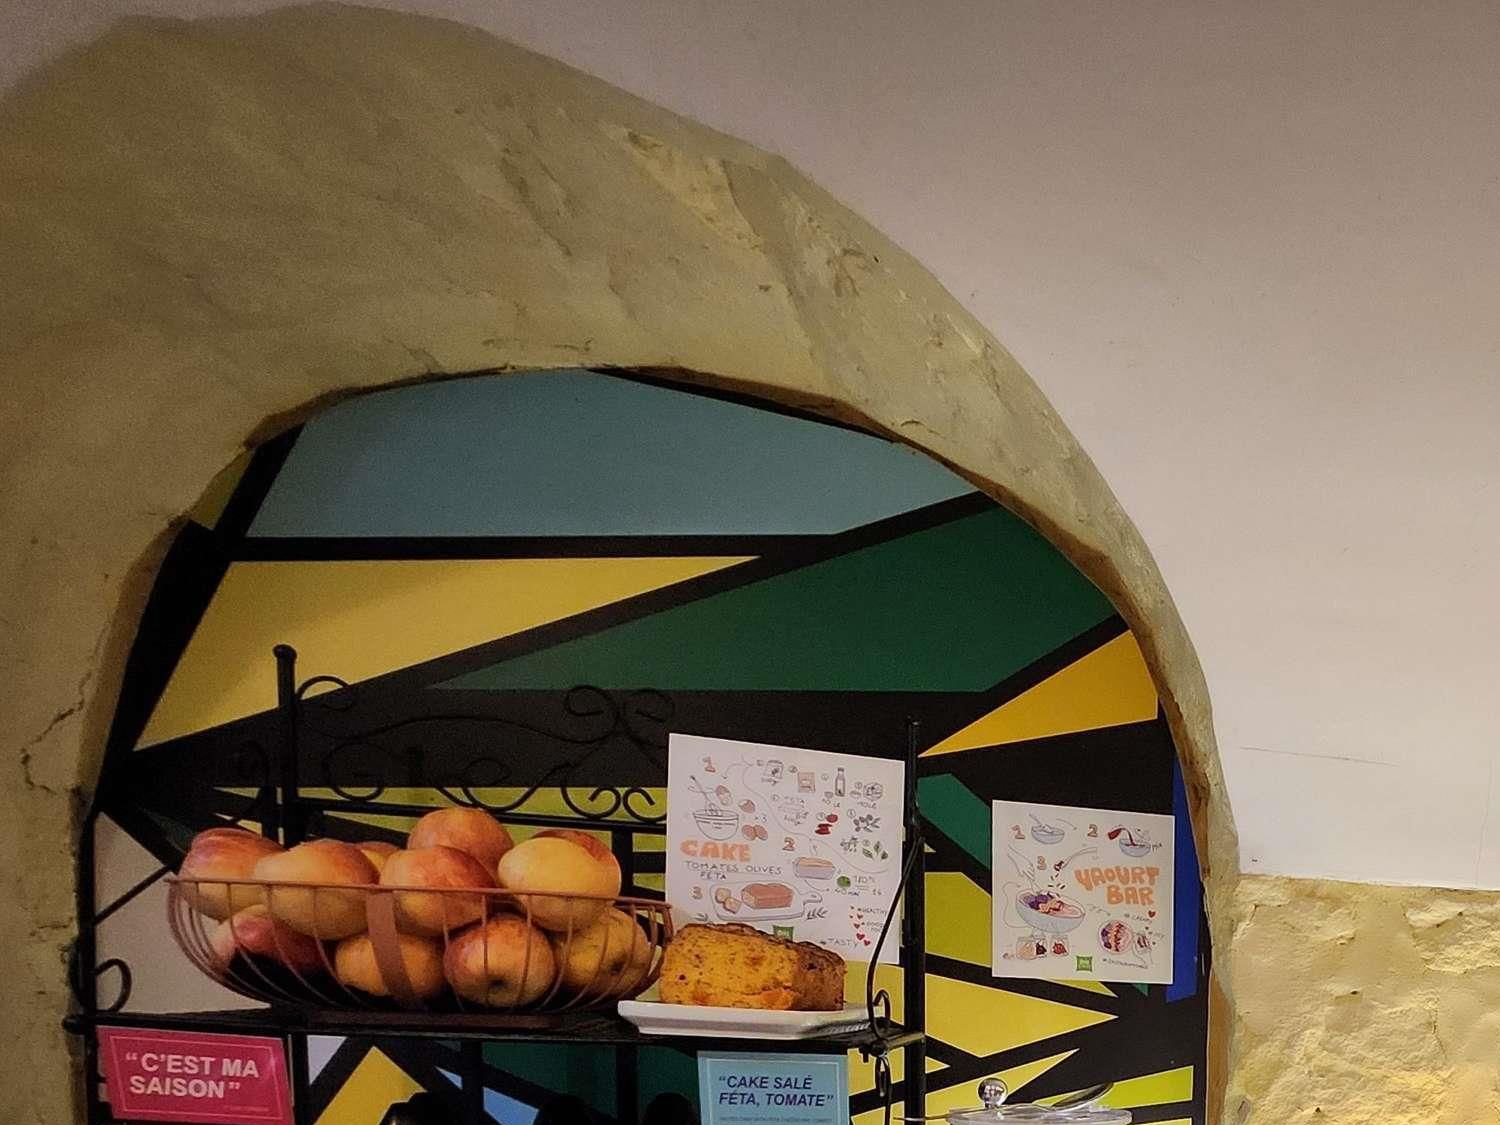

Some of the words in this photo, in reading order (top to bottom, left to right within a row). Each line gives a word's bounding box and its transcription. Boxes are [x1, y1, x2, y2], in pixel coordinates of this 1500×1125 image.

[1087, 824, 1098, 838] 2
[680, 839, 751, 862] CAKE
[782, 837, 795, 851] 2
[685, 860, 740, 873] TOMATES
[745, 865, 782, 875] OLIVES
[1074, 866, 1160, 891] YAOURT
[1106, 885, 1155, 906] BAR
[221, 1058, 260, 1078] MA
[773, 1074, 813, 1090] SALÉ
